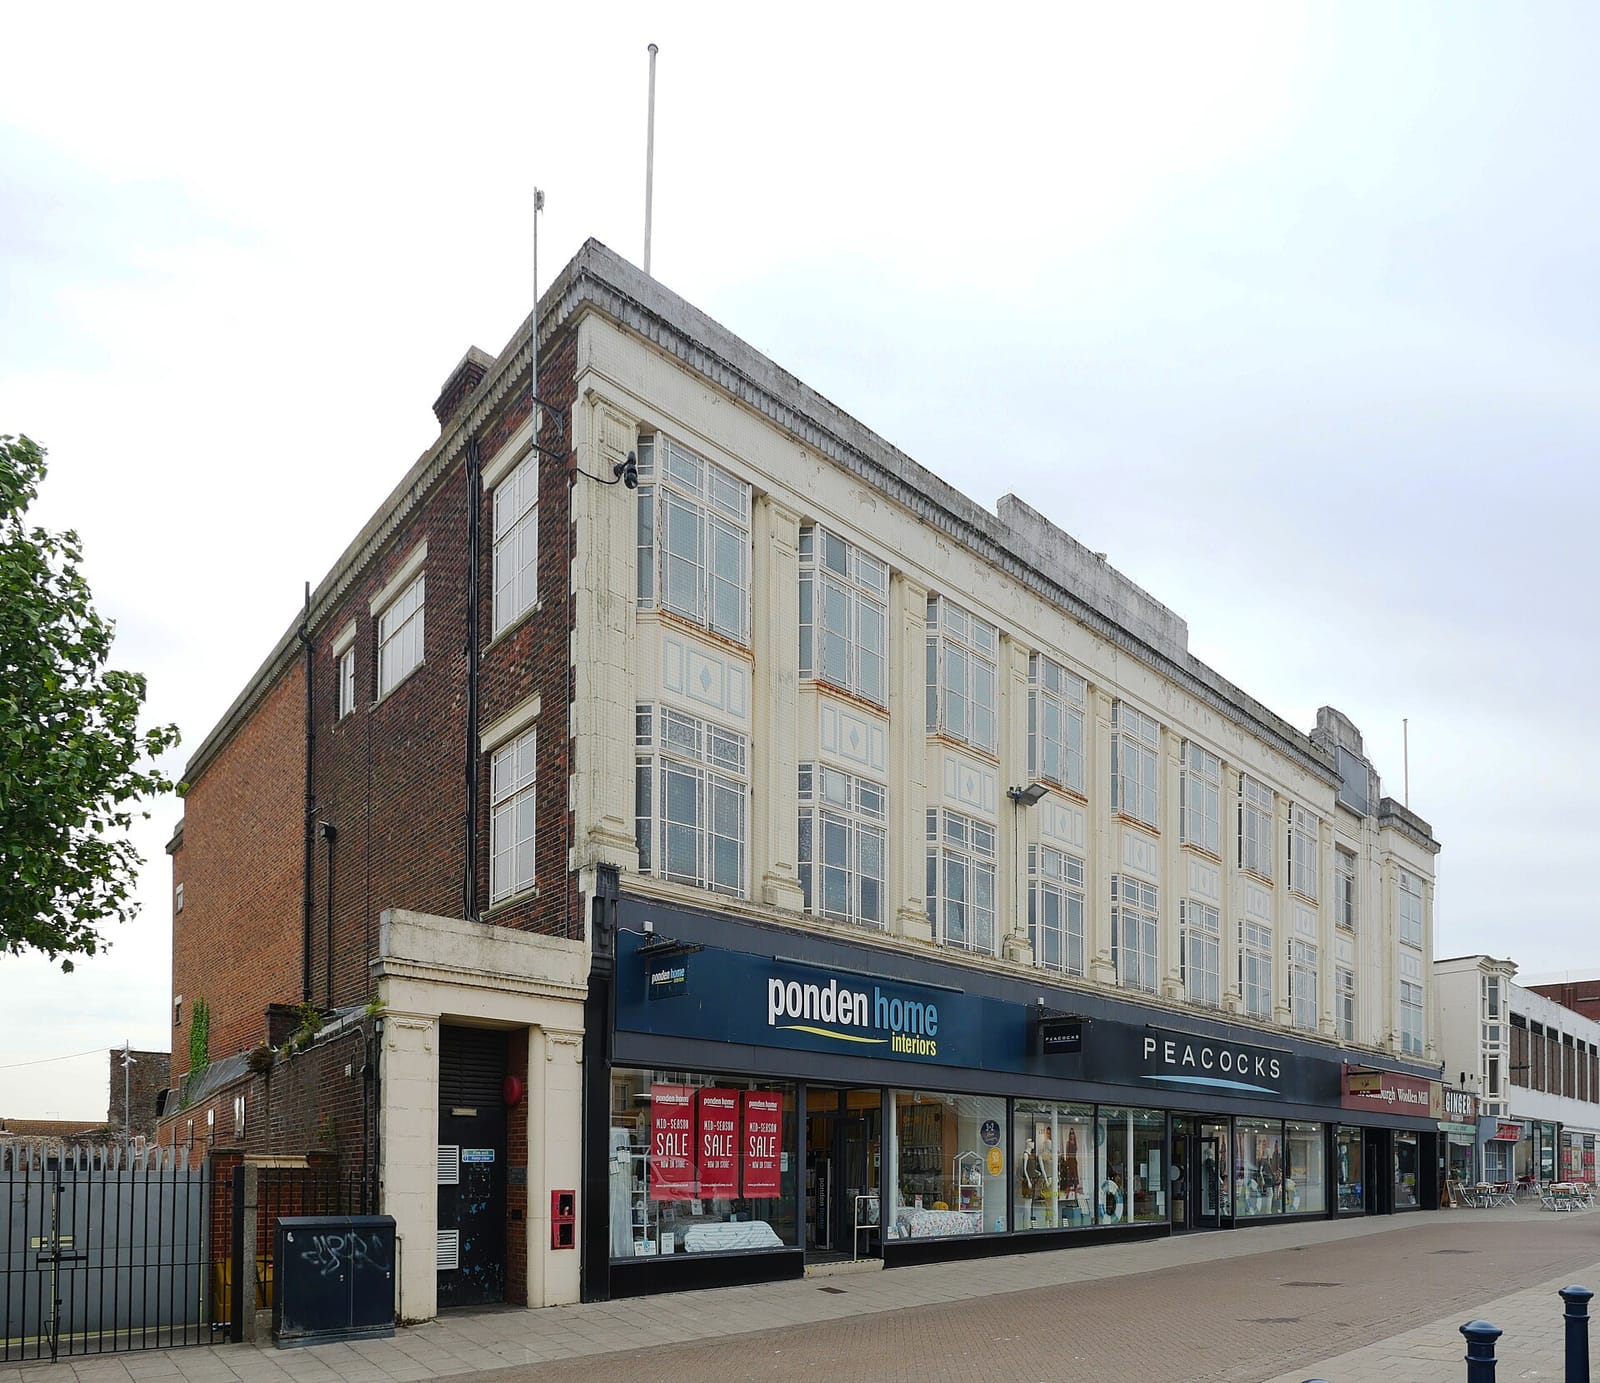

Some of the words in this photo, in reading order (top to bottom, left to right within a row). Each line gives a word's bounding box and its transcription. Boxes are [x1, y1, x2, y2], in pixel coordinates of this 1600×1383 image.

[651, 969, 670, 985] ponden
[670, 968, 685, 979] home
[768, 978, 868, 1026] ponden
[874, 986, 938, 1037] home
[891, 1031, 937, 1056] interiors
[1144, 1037, 1280, 1079] PEACOCKS
[656, 1094, 674, 1103] ponden
[675, 1094, 689, 1103] home
[704, 1097, 721, 1106] ponden
[721, 1097, 735, 1106] home
[748, 1100, 766, 1108] ponden
[1397, 1088, 1417, 1104] Woollen
[1418, 1090, 1429, 1105] Mill
[1445, 1091, 1471, 1115] GINGER
[656, 1118, 689, 1129] MID-SEASON
[704, 1121, 734, 1131] MID-SEASON
[749, 1123, 777, 1132] MID-SEASON
[656, 1133, 688, 1156] SALE
[704, 1134, 733, 1157] SALE
[749, 1136, 776, 1157] SALE
[675, 1160, 686, 1169] STORE
[720, 1161, 729, 1169] STORE
